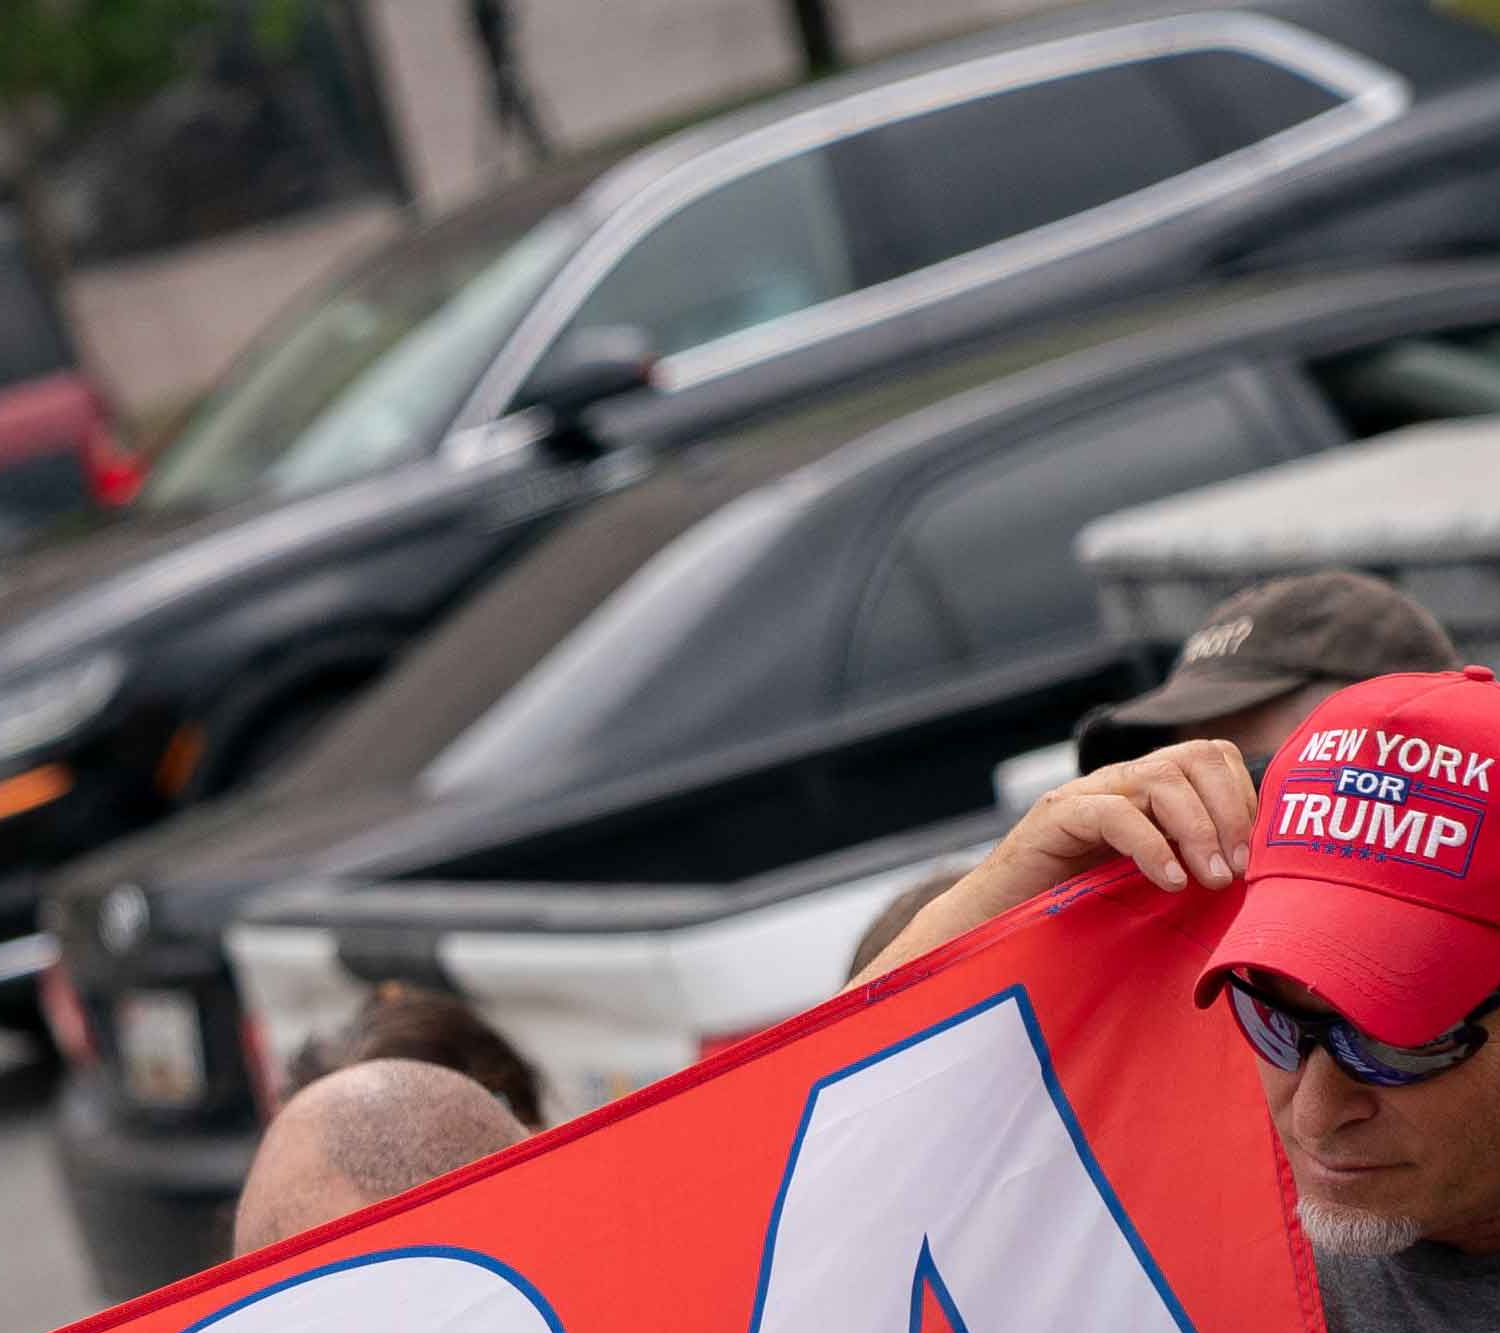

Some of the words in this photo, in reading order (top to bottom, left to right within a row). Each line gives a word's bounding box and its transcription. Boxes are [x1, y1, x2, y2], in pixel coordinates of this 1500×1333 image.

[1299, 728, 1369, 763] NEW
[1376, 730, 1496, 794] YORK
[1338, 769, 1407, 802] FOR
[1278, 792, 1469, 861] TRUMP
